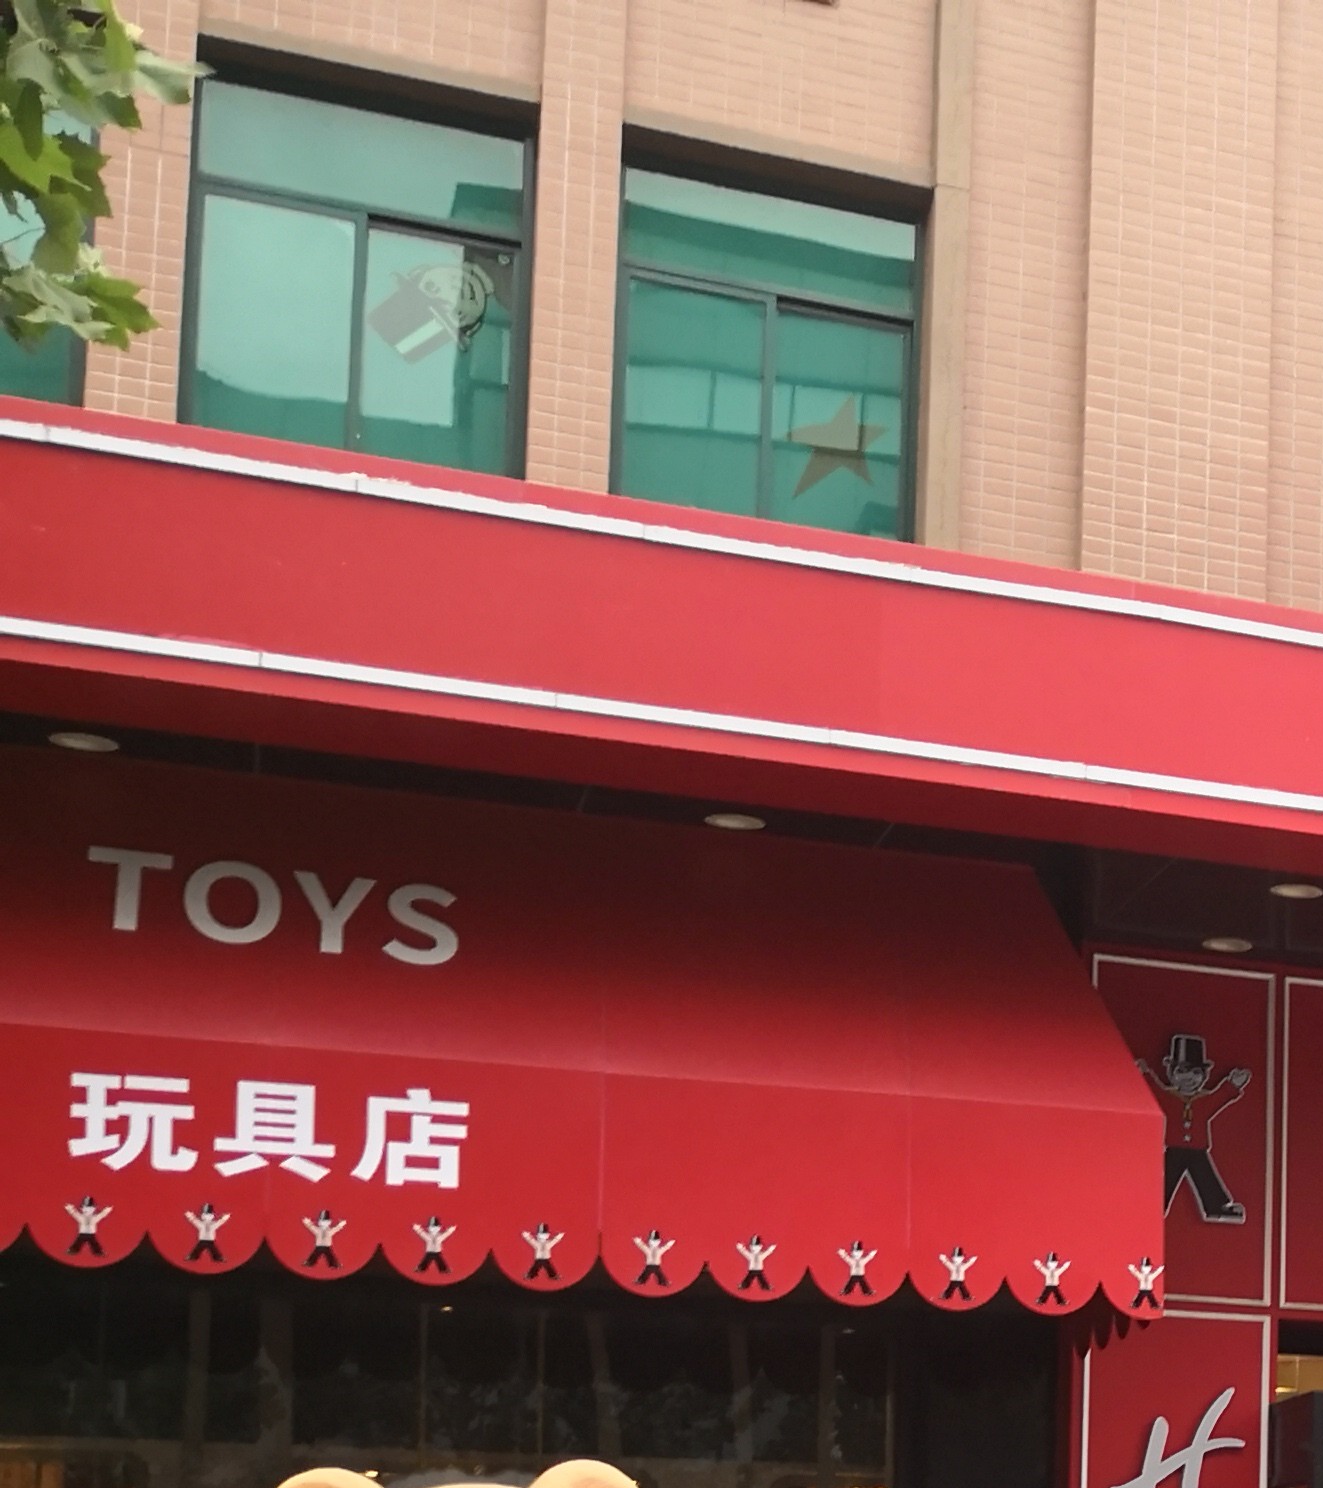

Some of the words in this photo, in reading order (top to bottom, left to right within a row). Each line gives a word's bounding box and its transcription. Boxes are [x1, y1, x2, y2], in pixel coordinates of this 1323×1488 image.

[87, 844, 461, 966] TOYS
[67, 1070, 471, 1190] 玩具店
